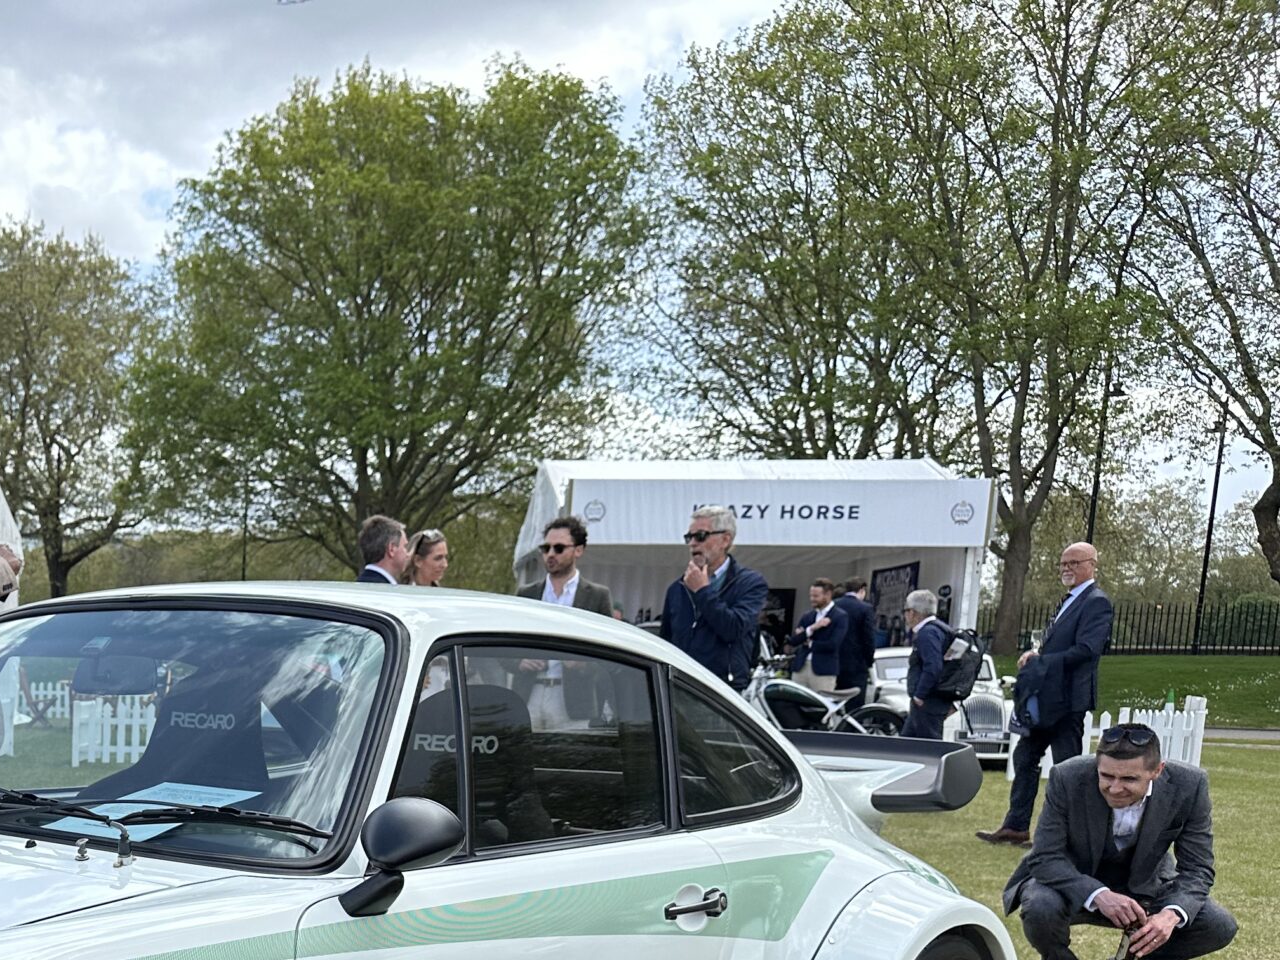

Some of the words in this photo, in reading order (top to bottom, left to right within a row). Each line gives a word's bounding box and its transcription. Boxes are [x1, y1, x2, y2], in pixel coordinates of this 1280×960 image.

[693, 504, 770, 520] AZY
[779, 504, 860, 520] HORSE
[170, 711, 236, 730] RECARO
[413, 733, 499, 754] RECRO
